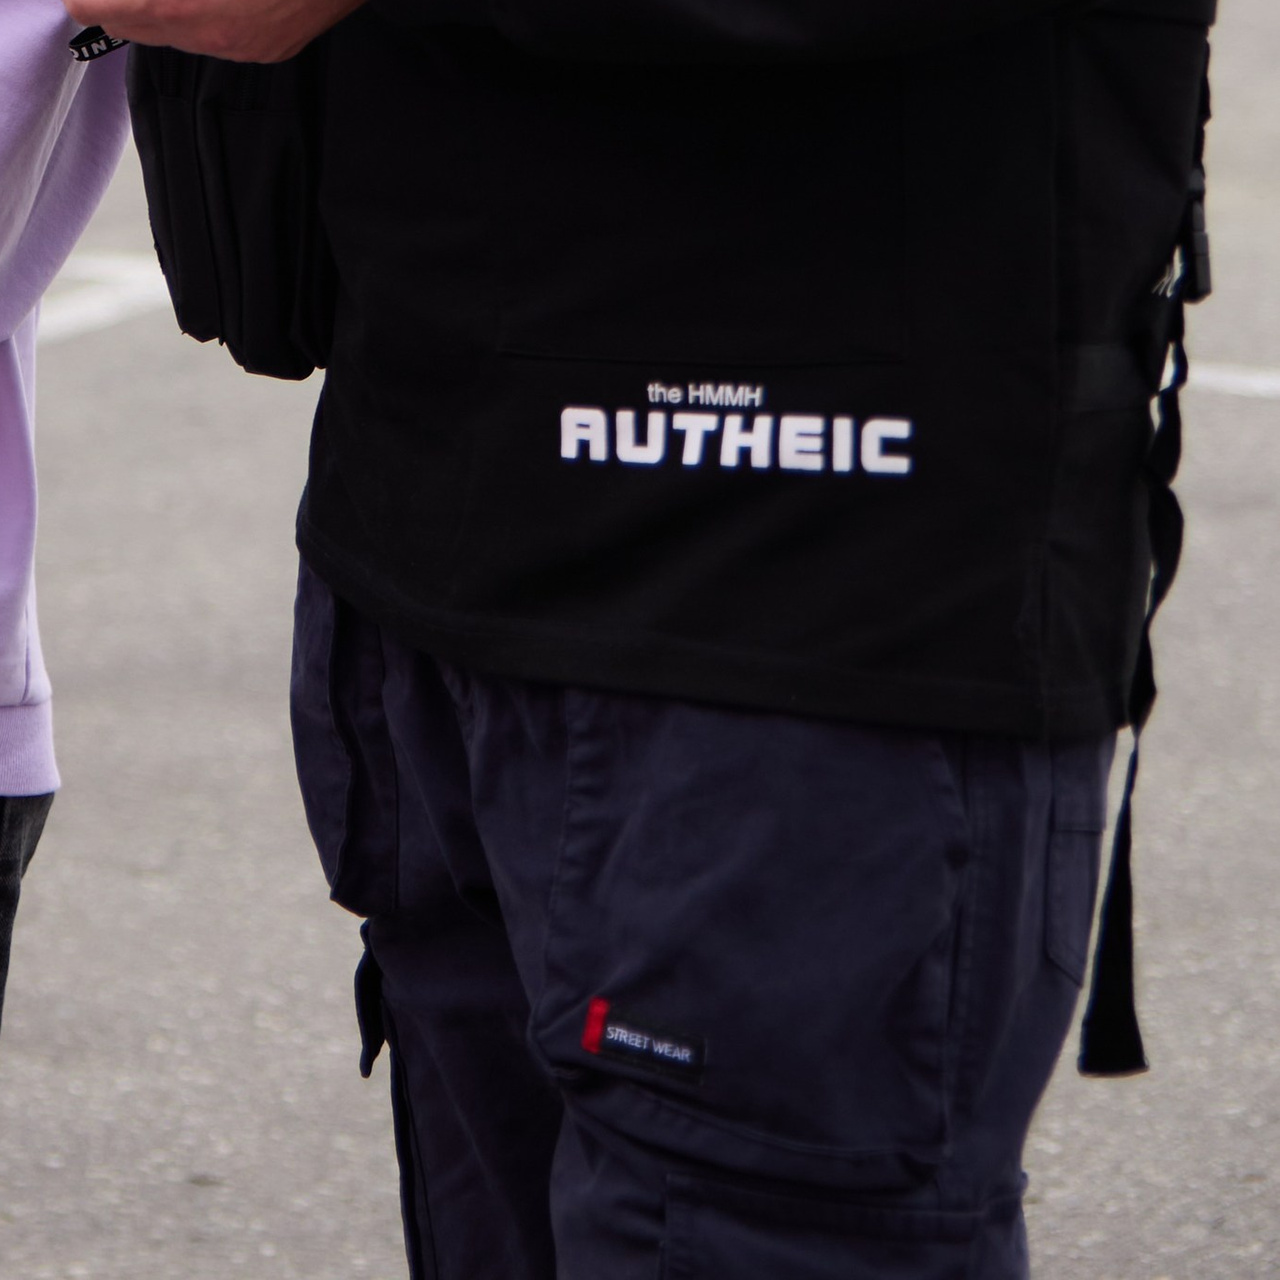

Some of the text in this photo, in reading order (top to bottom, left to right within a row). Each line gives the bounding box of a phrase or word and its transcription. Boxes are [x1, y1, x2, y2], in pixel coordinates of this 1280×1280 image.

[646, 382, 764, 408] the HMMH
[559, 405, 913, 475] AUTHEIC
[606, 1025, 692, 1063] STREET WEAR
